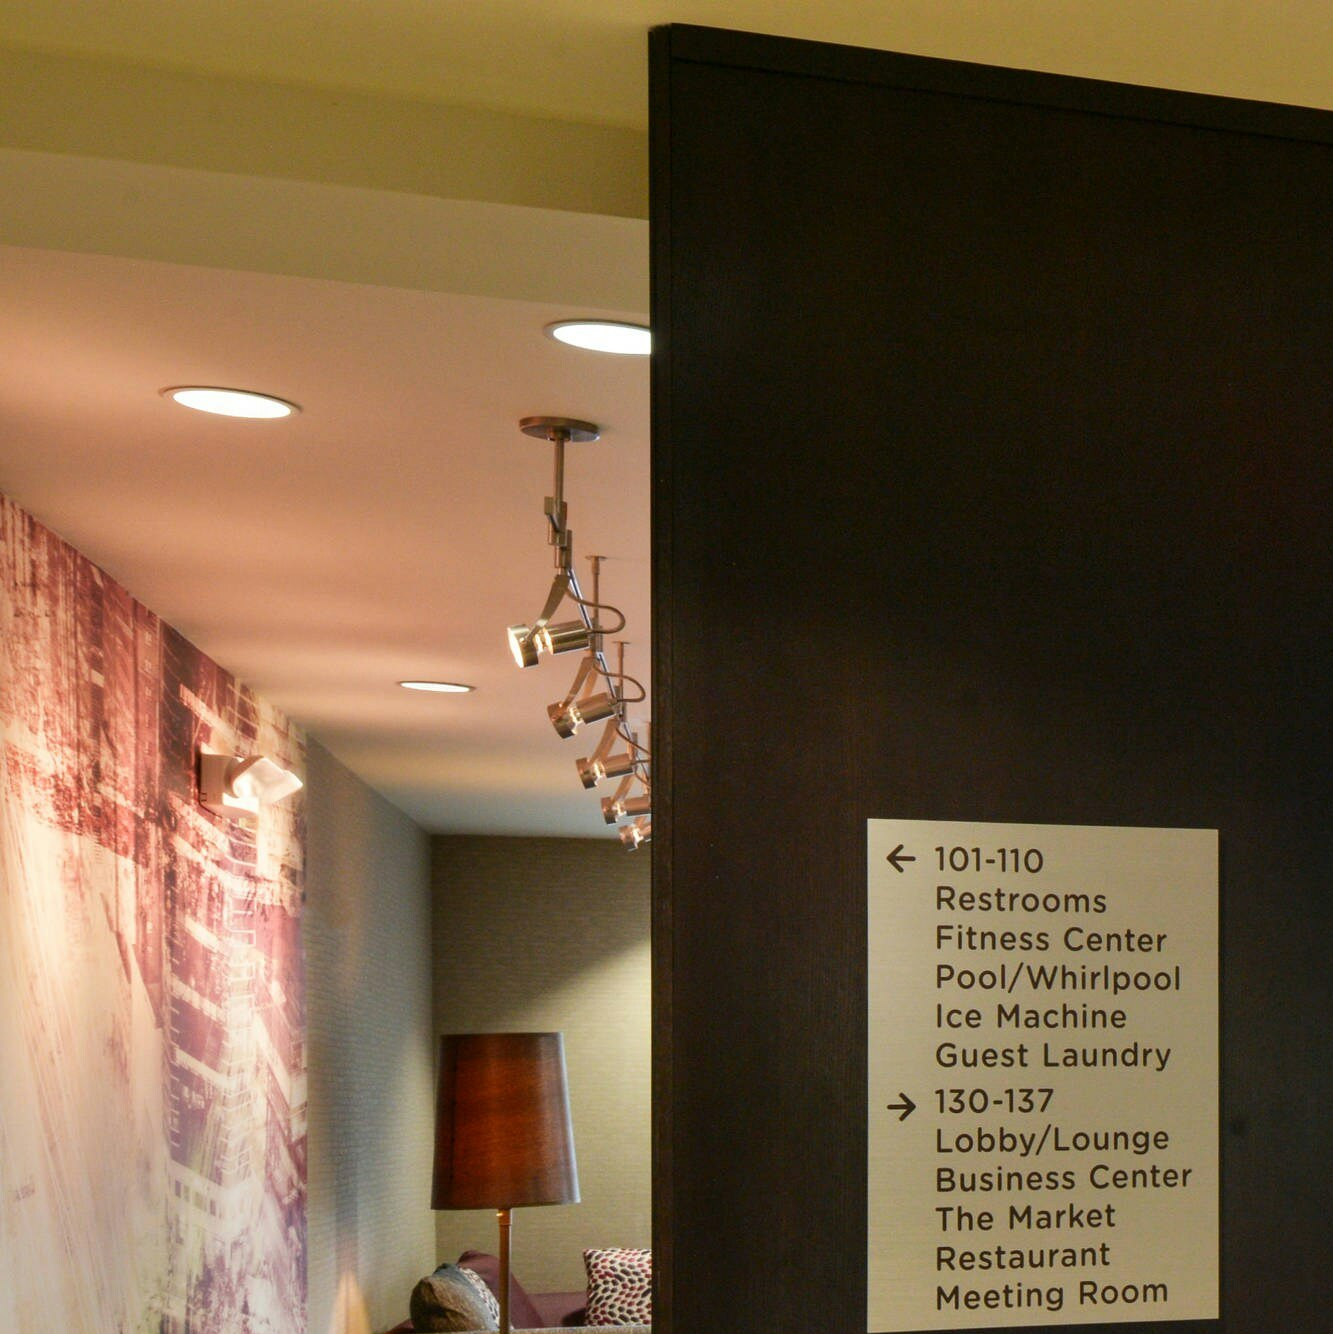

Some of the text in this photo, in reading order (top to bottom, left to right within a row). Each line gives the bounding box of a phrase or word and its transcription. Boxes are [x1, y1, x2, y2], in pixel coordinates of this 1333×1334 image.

[936, 847, 1043, 873] 101-110
[937, 886, 1106, 913] Restrooms
[937, 925, 1167, 952] Fitness Center
[937, 963, 1179, 995] Pool/Whirlpool
[938, 1004, 1126, 1028] Ice Machine
[936, 1042, 1170, 1071] Guest Laundry
[936, 1089, 1053, 1113] 130-137
[937, 1124, 1168, 1156] Lobby/Lounge
[937, 1165, 1192, 1192] Business Center
[936, 1203, 1115, 1231] The Market
[937, 1243, 1109, 1271] Restaurant
[937, 1281, 1167, 1311] Meeting Room
